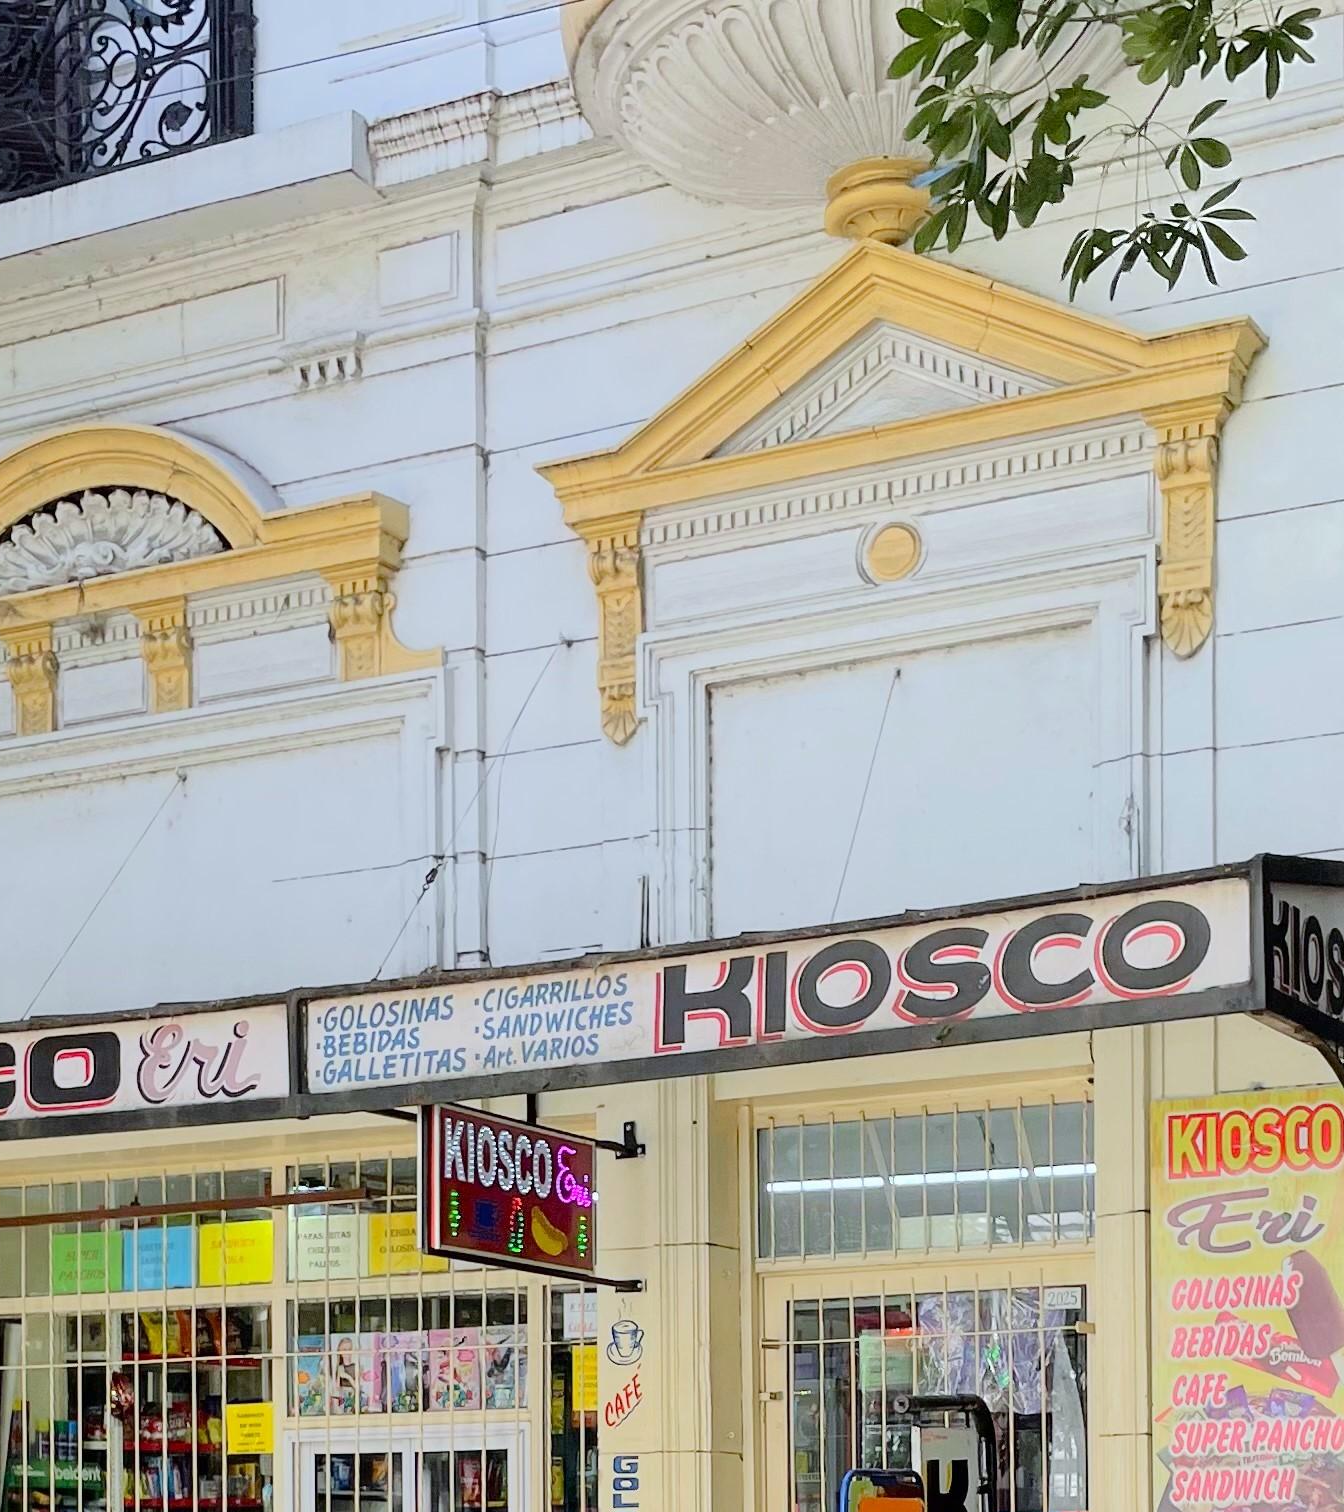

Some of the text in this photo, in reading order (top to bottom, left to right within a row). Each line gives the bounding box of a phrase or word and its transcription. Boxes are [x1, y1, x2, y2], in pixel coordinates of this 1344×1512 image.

[482, 973, 629, 1013] CIGARRILLOS
[656, 900, 1211, 1053] KIOSCO
[323, 994, 454, 1033] GOLOSINAS
[482, 1001, 633, 1041] SANDWICHES
[323, 1027, 421, 1058] BEBIDAS
[482, 1034, 600, 1070] Art. VARIOS
[137, 1020, 262, 1104] Eri
[323, 1048, 466, 1085] GALLETITAS
[444, 1117, 553, 1199] KIOSCO
[1167, 1187, 1325, 1254] Eri
[1171, 1274, 1302, 1311] GOLOSINAS
[1171, 1324, 1271, 1358] BEBIDAS
[605, 1363, 643, 1427] CAFÉ
[1172, 1374, 1228, 1407] CAFE
[1171, 1419, 1246, 1454] SUPER
[1172, 1468, 1296, 1502] SANDWICH
